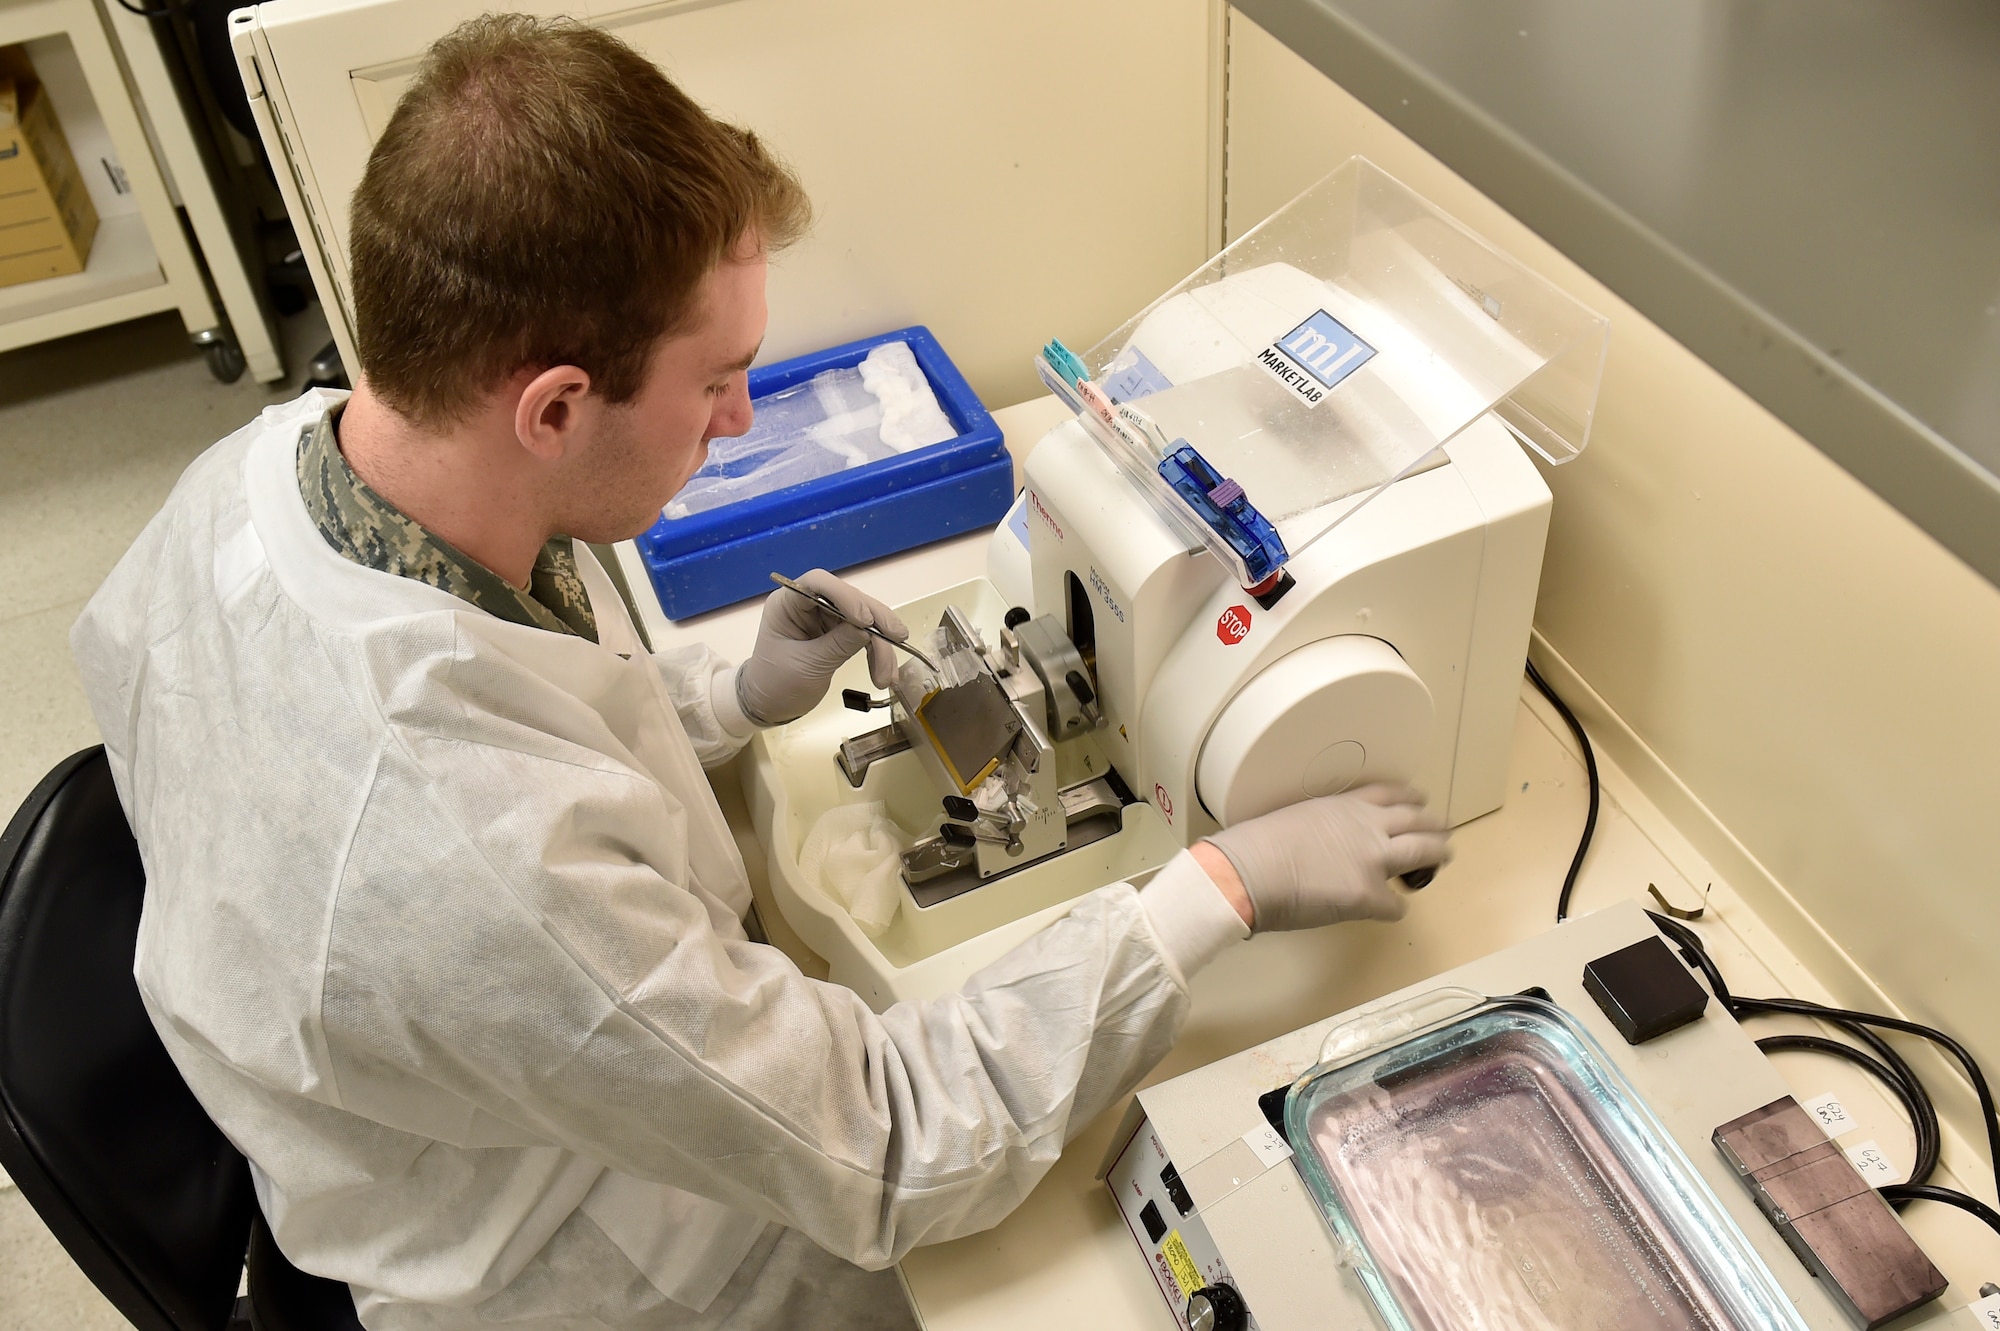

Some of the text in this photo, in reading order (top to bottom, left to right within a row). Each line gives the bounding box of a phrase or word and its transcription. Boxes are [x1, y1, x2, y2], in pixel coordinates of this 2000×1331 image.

[1285, 326, 1363, 379] ml
[1257, 348, 1323, 403] MARKETLAB
[1030, 490, 1064, 540] Thermo
[1089, 573, 1102, 596] HM
[1220, 609, 1248, 639] STOP
[1826, 1102, 1846, 1121] 624
[1150, 1135, 1165, 1159] POWER
[1857, 1161, 1869, 1172] 2
[1862, 1149, 1888, 1171] 627
[1131, 1179, 1143, 1197] LAMP
